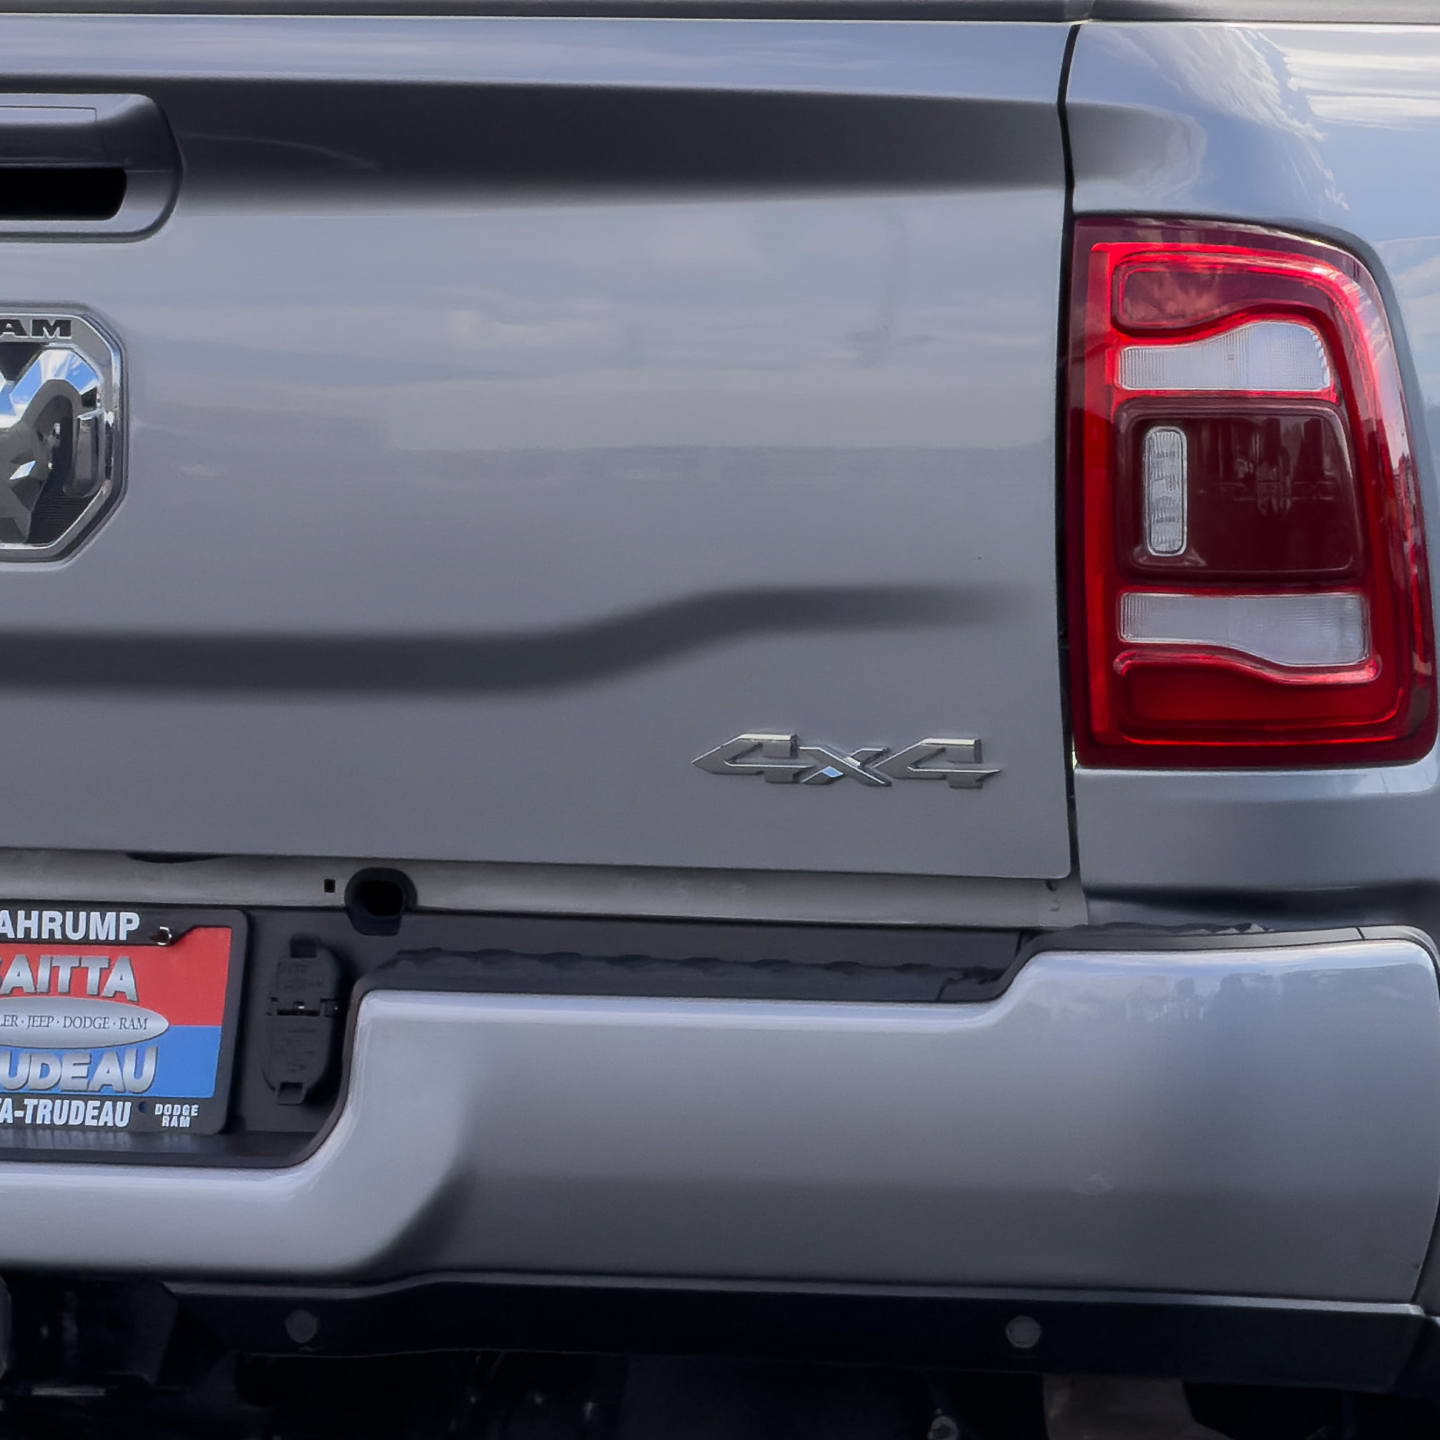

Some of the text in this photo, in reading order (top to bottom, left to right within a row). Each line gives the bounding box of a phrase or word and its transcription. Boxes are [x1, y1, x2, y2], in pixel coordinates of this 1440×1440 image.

[25, 1014, 56, 1030] JEEP
[62, 1015, 111, 1031] DODGE
[118, 1017, 149, 1031] RAM
[154, 1102, 200, 1118] DODGE
[161, 1115, 192, 1129] RAM
